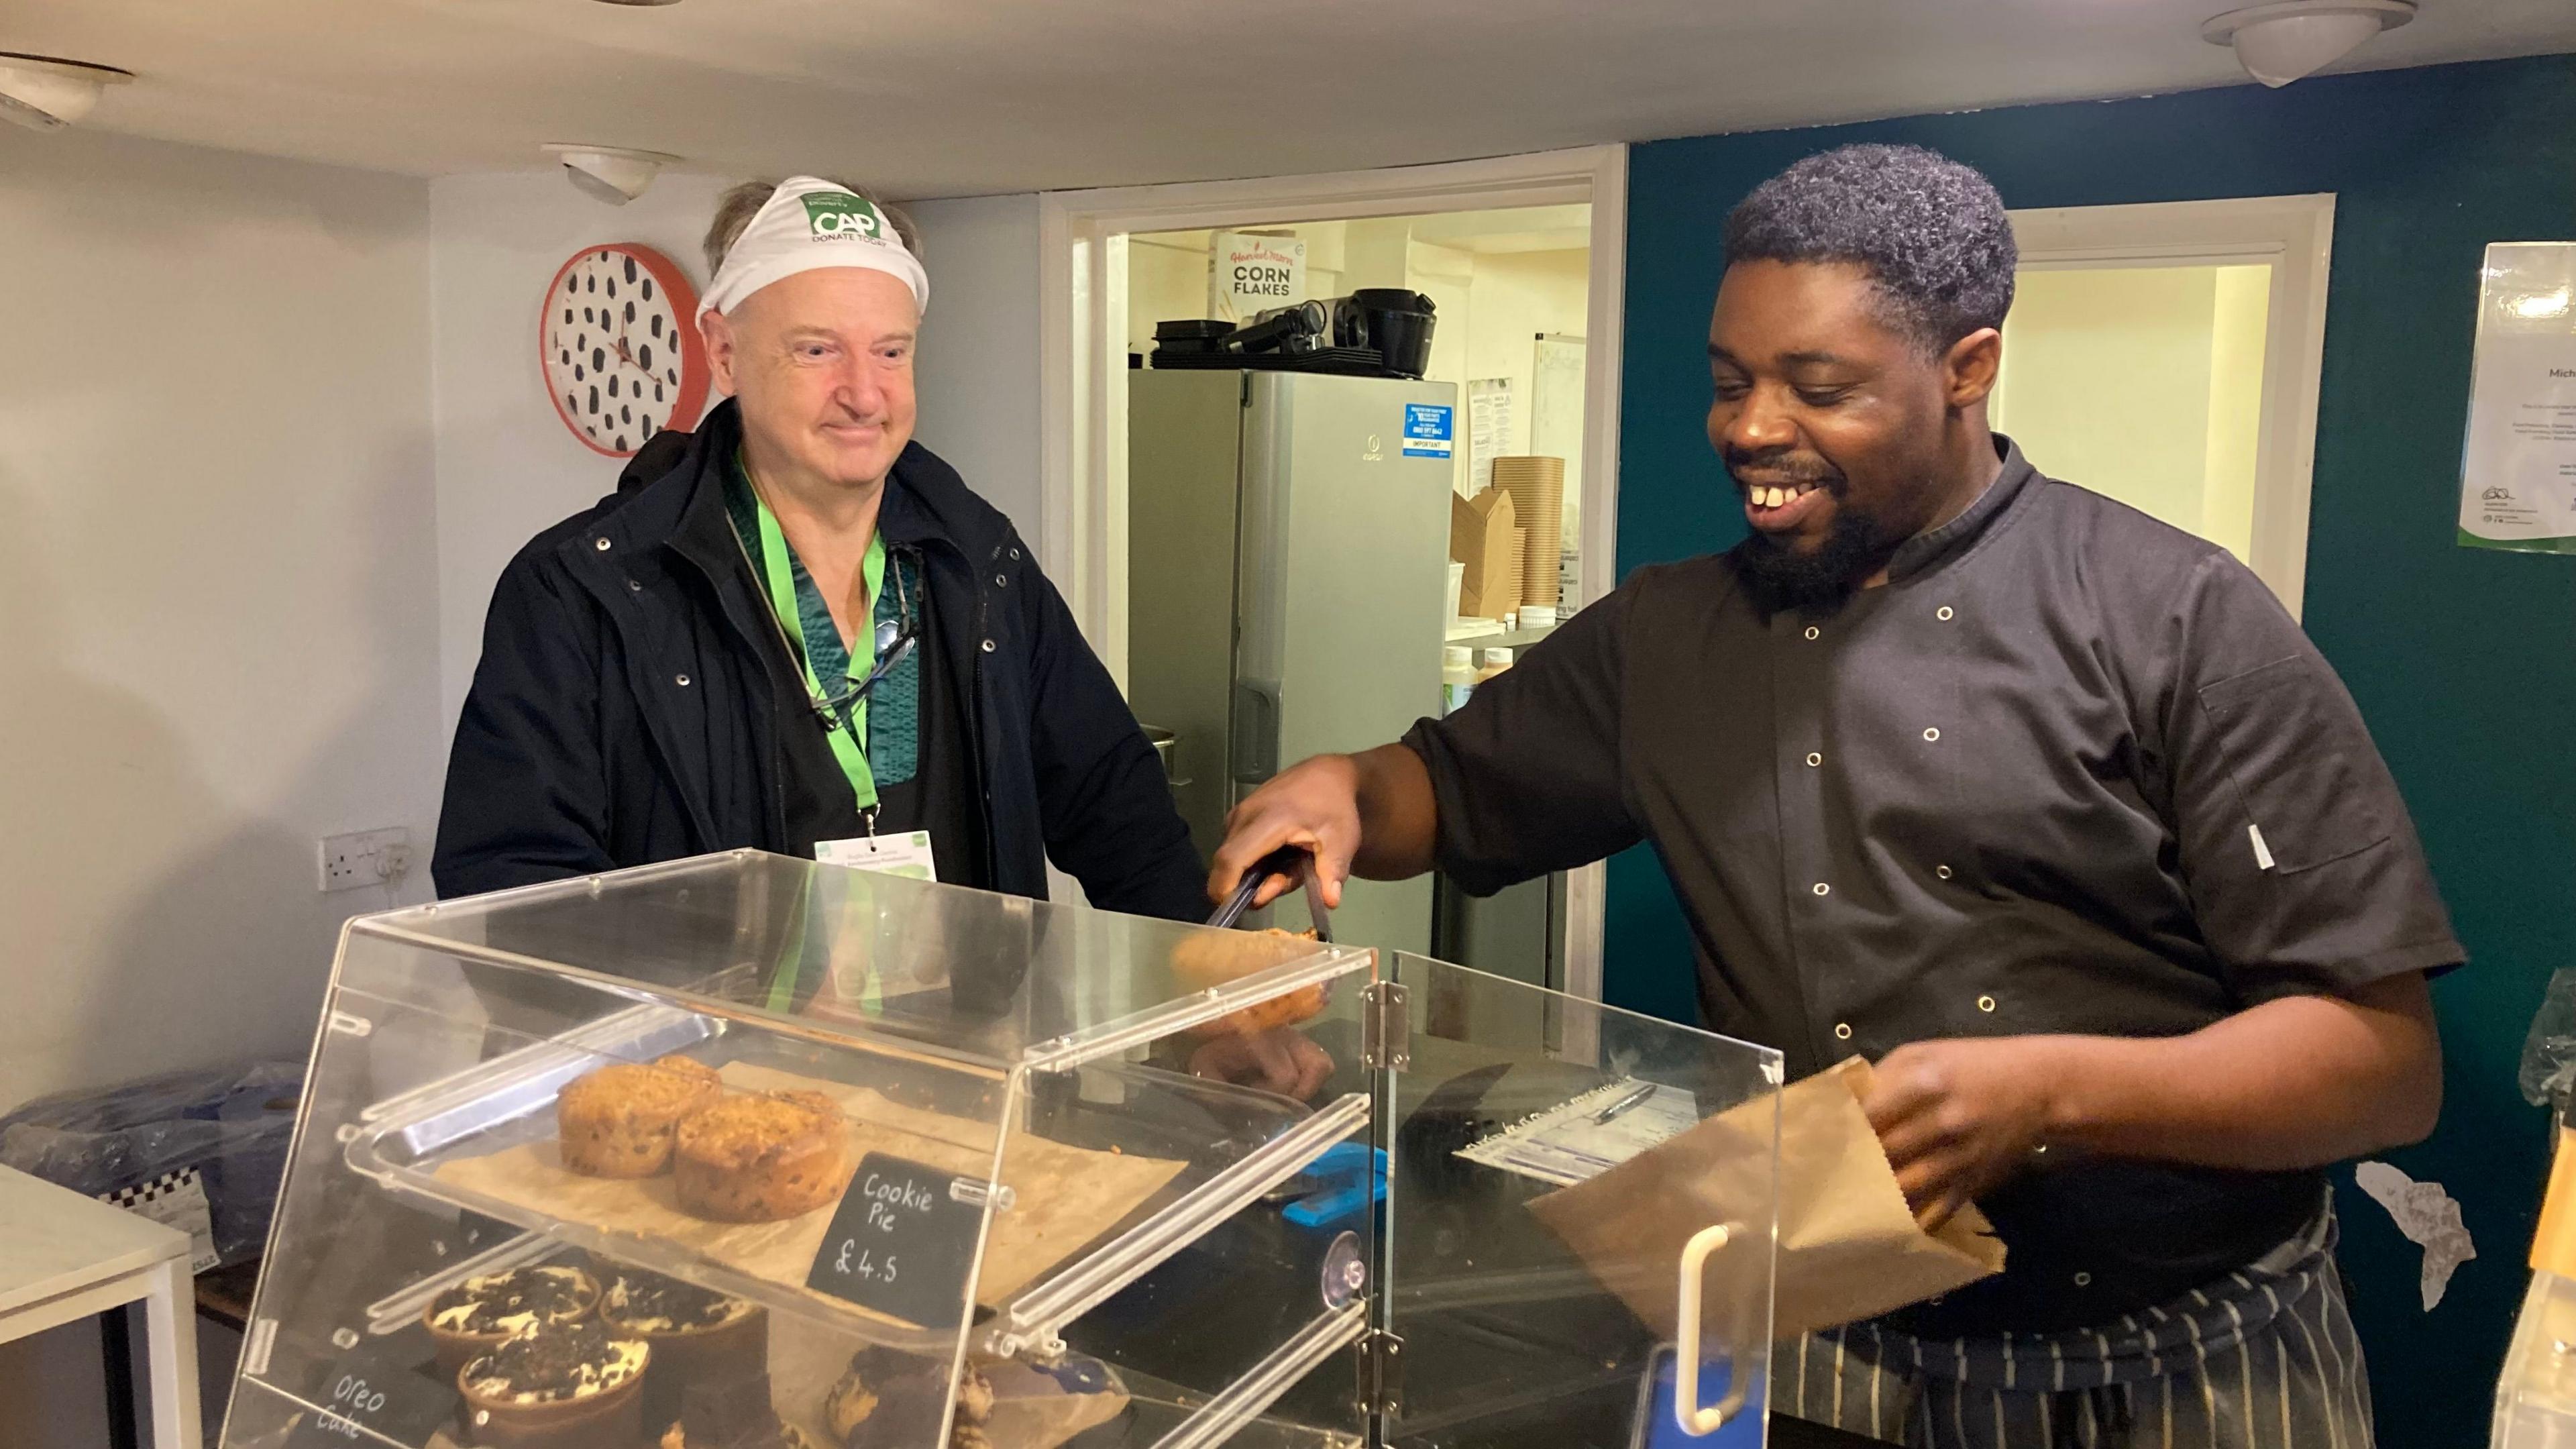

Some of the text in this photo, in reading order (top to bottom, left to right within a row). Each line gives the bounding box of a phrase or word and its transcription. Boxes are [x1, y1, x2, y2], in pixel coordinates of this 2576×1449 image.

[814, 212, 875, 235] CAP
[812, 234, 887, 248] DONATE TODAY
[1234, 266, 1290, 283] CORN
[1234, 282, 1289, 296] FLAKES
[1413, 440, 1441, 448] IMPORTANT
[863, 1173, 932, 1211] Cookie
[868, 1202, 896, 1232] Pie
[334, 1375, 386, 1411] Oreo
